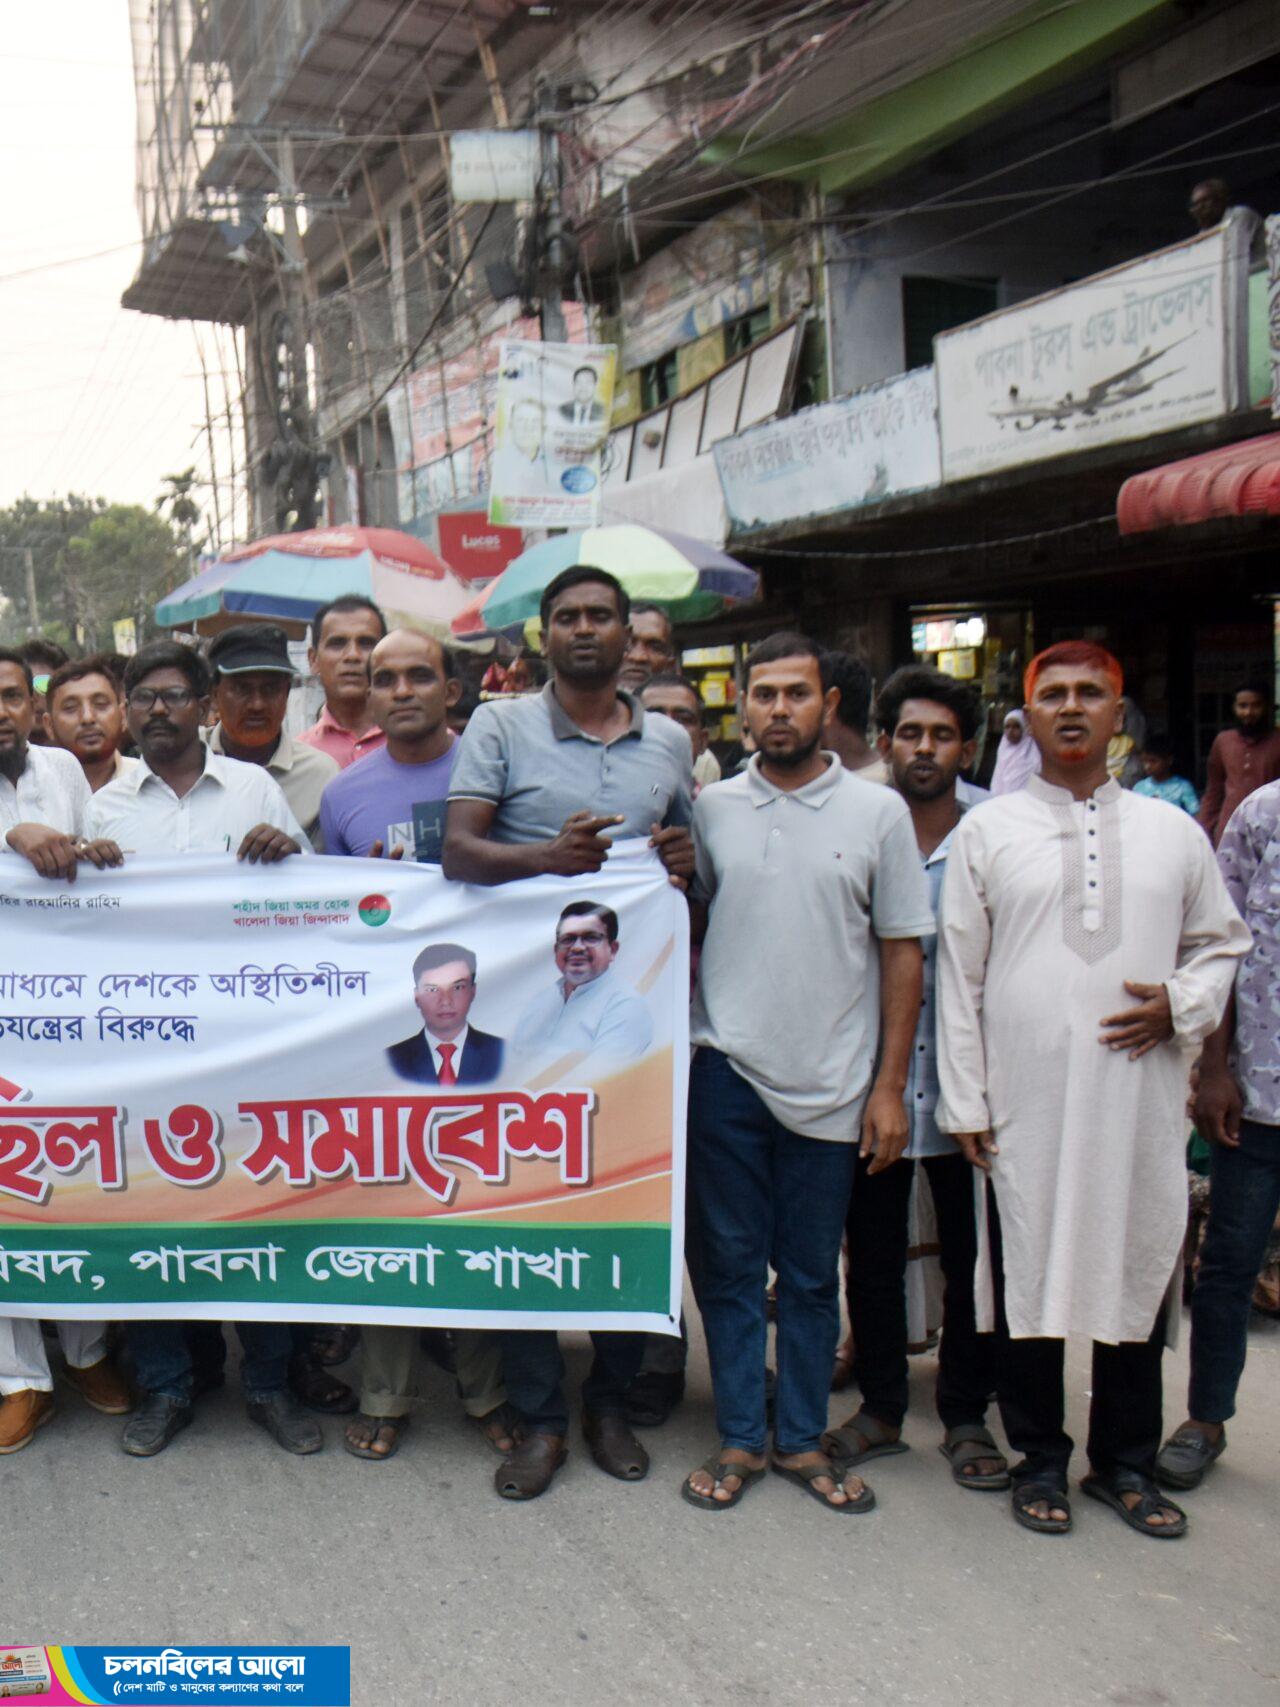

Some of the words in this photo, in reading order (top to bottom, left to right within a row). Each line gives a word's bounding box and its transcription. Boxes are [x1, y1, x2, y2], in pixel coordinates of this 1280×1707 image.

[86, 893, 122, 910] রাহিম
[232, 898, 261, 914] শহীদ
[265, 898, 289, 913] জিয়া
[294, 899, 321, 913] অমর
[324, 898, 351, 911] হোক
[233, 915, 271, 928] খালেদা
[274, 913, 299, 928] জিয়া
[303, 911, 351, 926] জিন্দাবাদ
[98, 970, 200, 999] দেশকে
[208, 961, 372, 1004] অস্থিতিশীল
[95, 1005, 200, 1044] বিরুদ্ধে
[141, 1100, 222, 1186] ও
[236, 1087, 595, 1203] সমাবেশ
[128, 1241, 286, 1284] পাবনা
[304, 1242, 446, 1287] জেলা
[455, 1245, 592, 1290] শাখা
